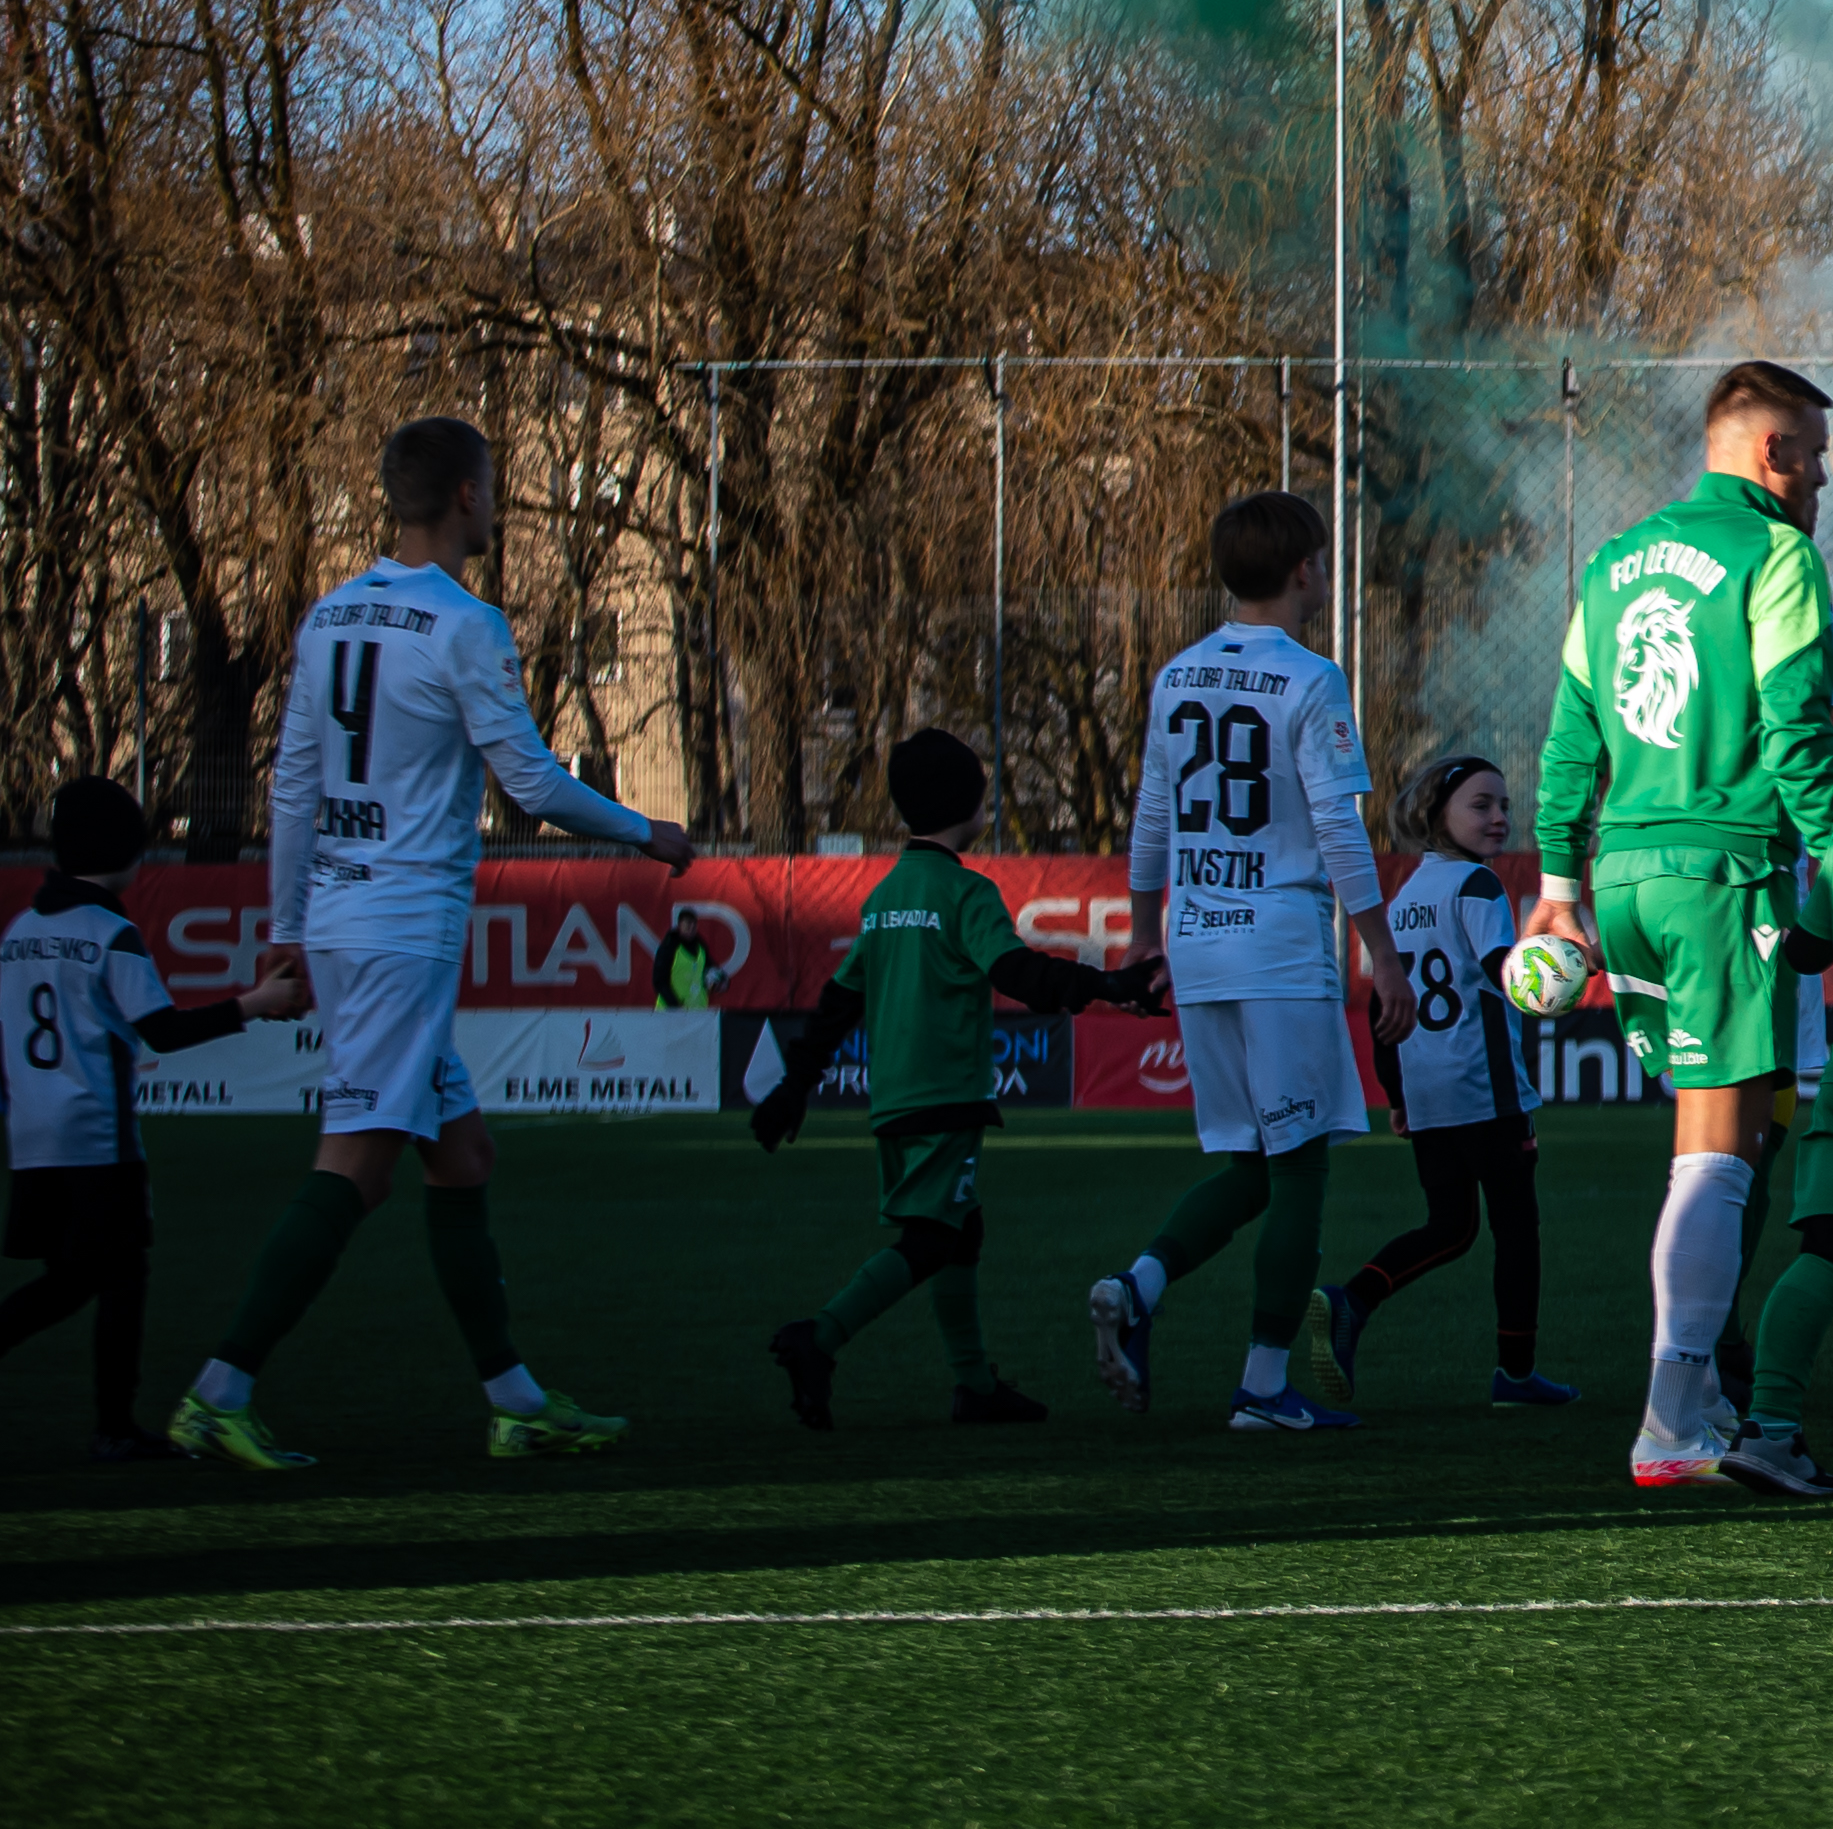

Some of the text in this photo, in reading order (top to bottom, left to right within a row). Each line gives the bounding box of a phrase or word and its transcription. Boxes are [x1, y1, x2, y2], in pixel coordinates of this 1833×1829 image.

[1610, 539, 1728, 597] FCI LEVADIA
[366, 602, 439, 637] TALLINN
[1165, 666, 1291, 696] FC FLORA TALLINN
[332, 640, 382, 786] 4
[1169, 700, 1272, 837] 28
[880, 910, 942, 931] LEVADIA
[1202, 908, 1255, 930] SELVER
[23, 981, 62, 1070] 8
[506, 1076, 700, 1104] ELME METALL
